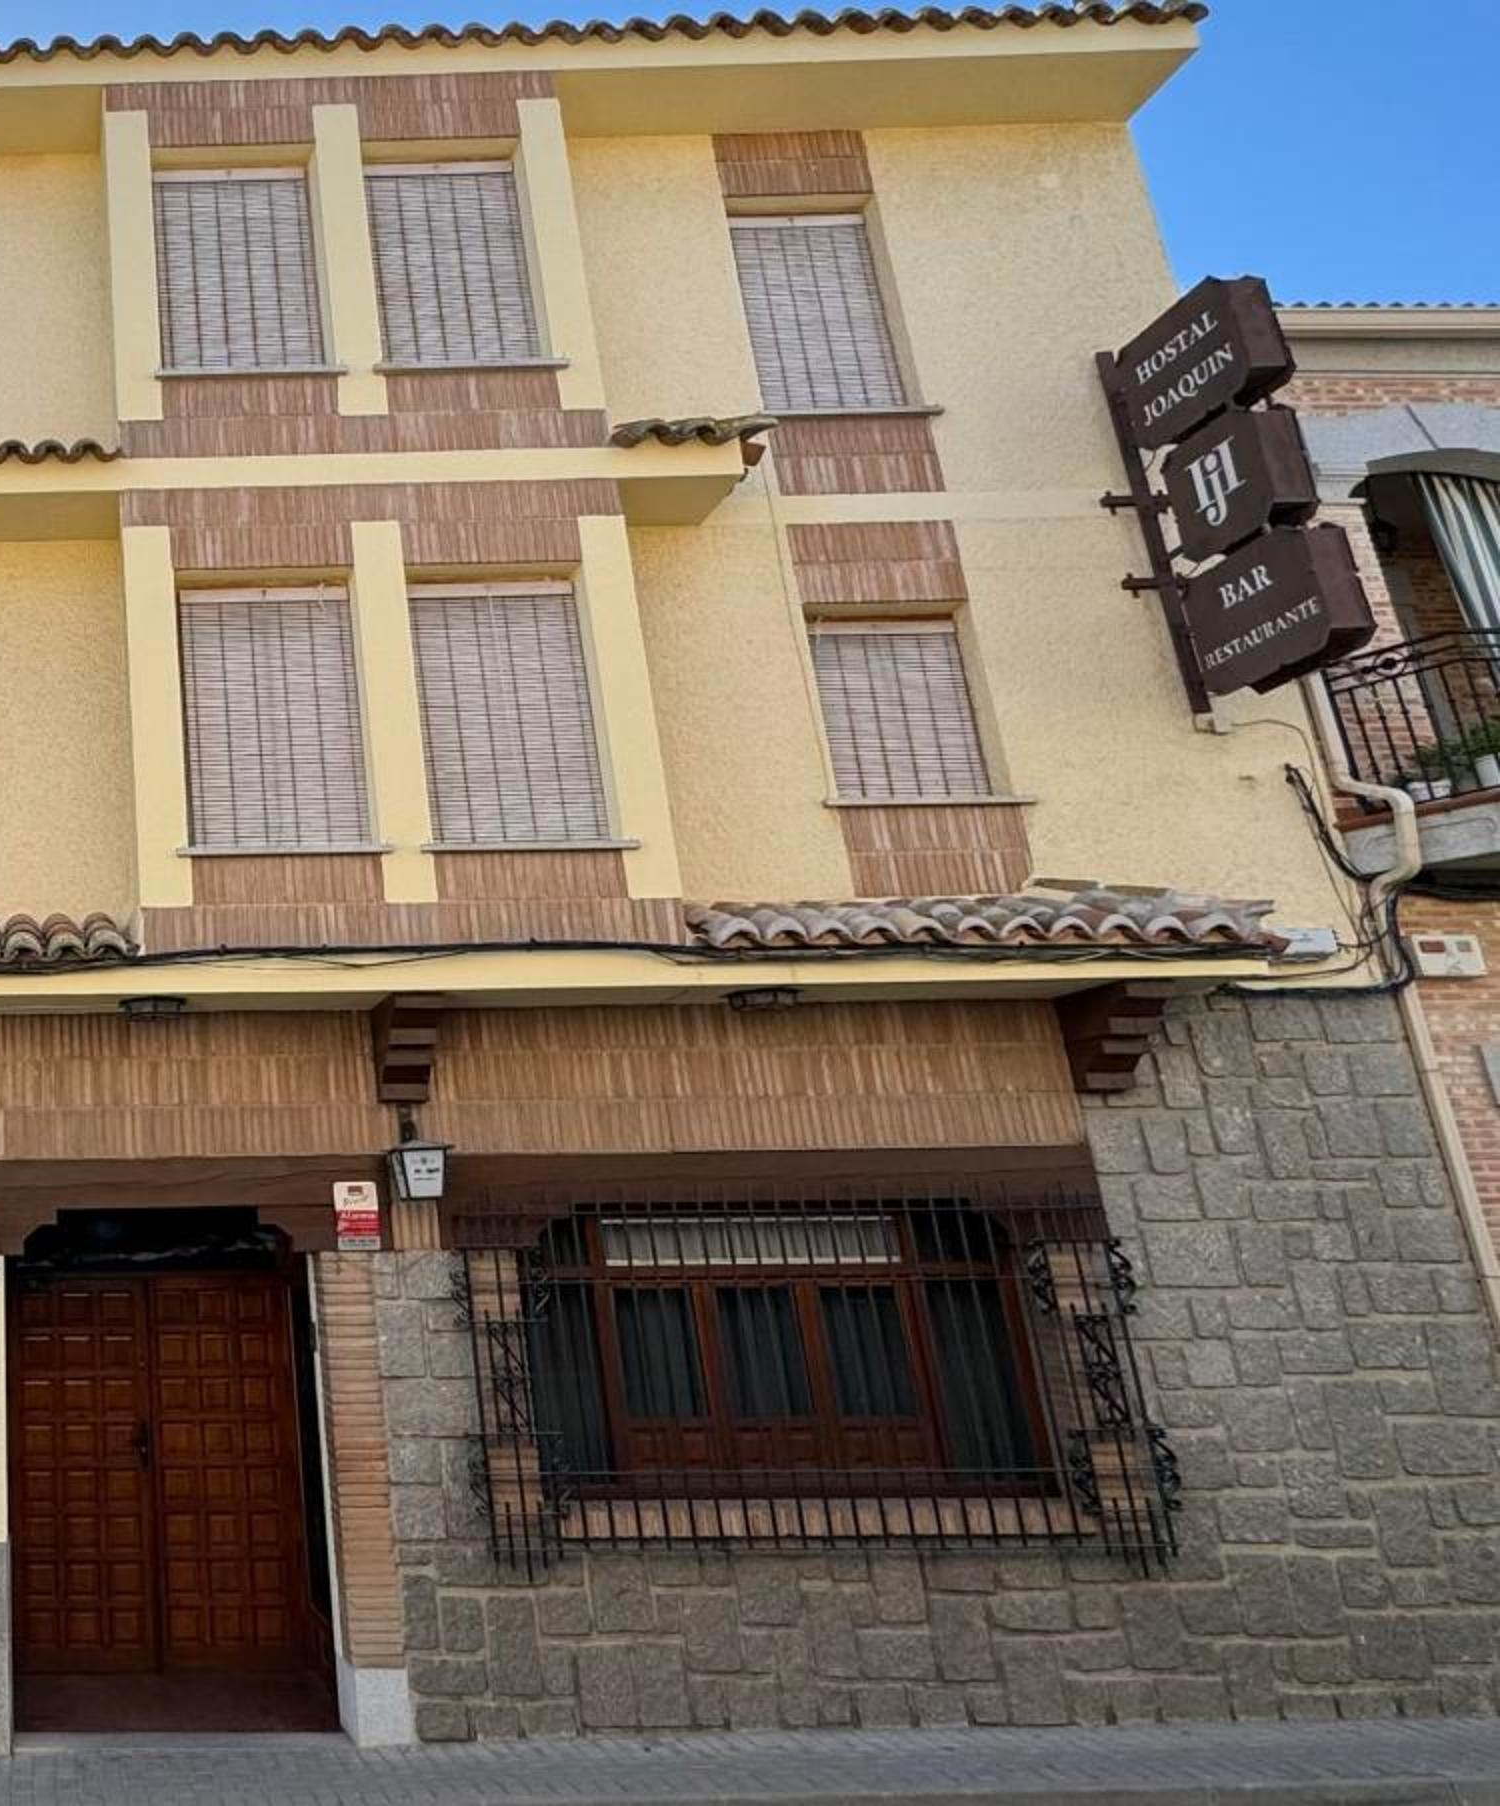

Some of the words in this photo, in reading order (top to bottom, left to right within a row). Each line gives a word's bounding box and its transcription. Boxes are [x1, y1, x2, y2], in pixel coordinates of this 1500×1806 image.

[1135, 311, 1218, 385] HOSTAL
[1143, 341, 1234, 427] JOAQUIN
[1219, 564, 1273, 609] BAR
[1203, 596, 1319, 670] RESTAURANTE
